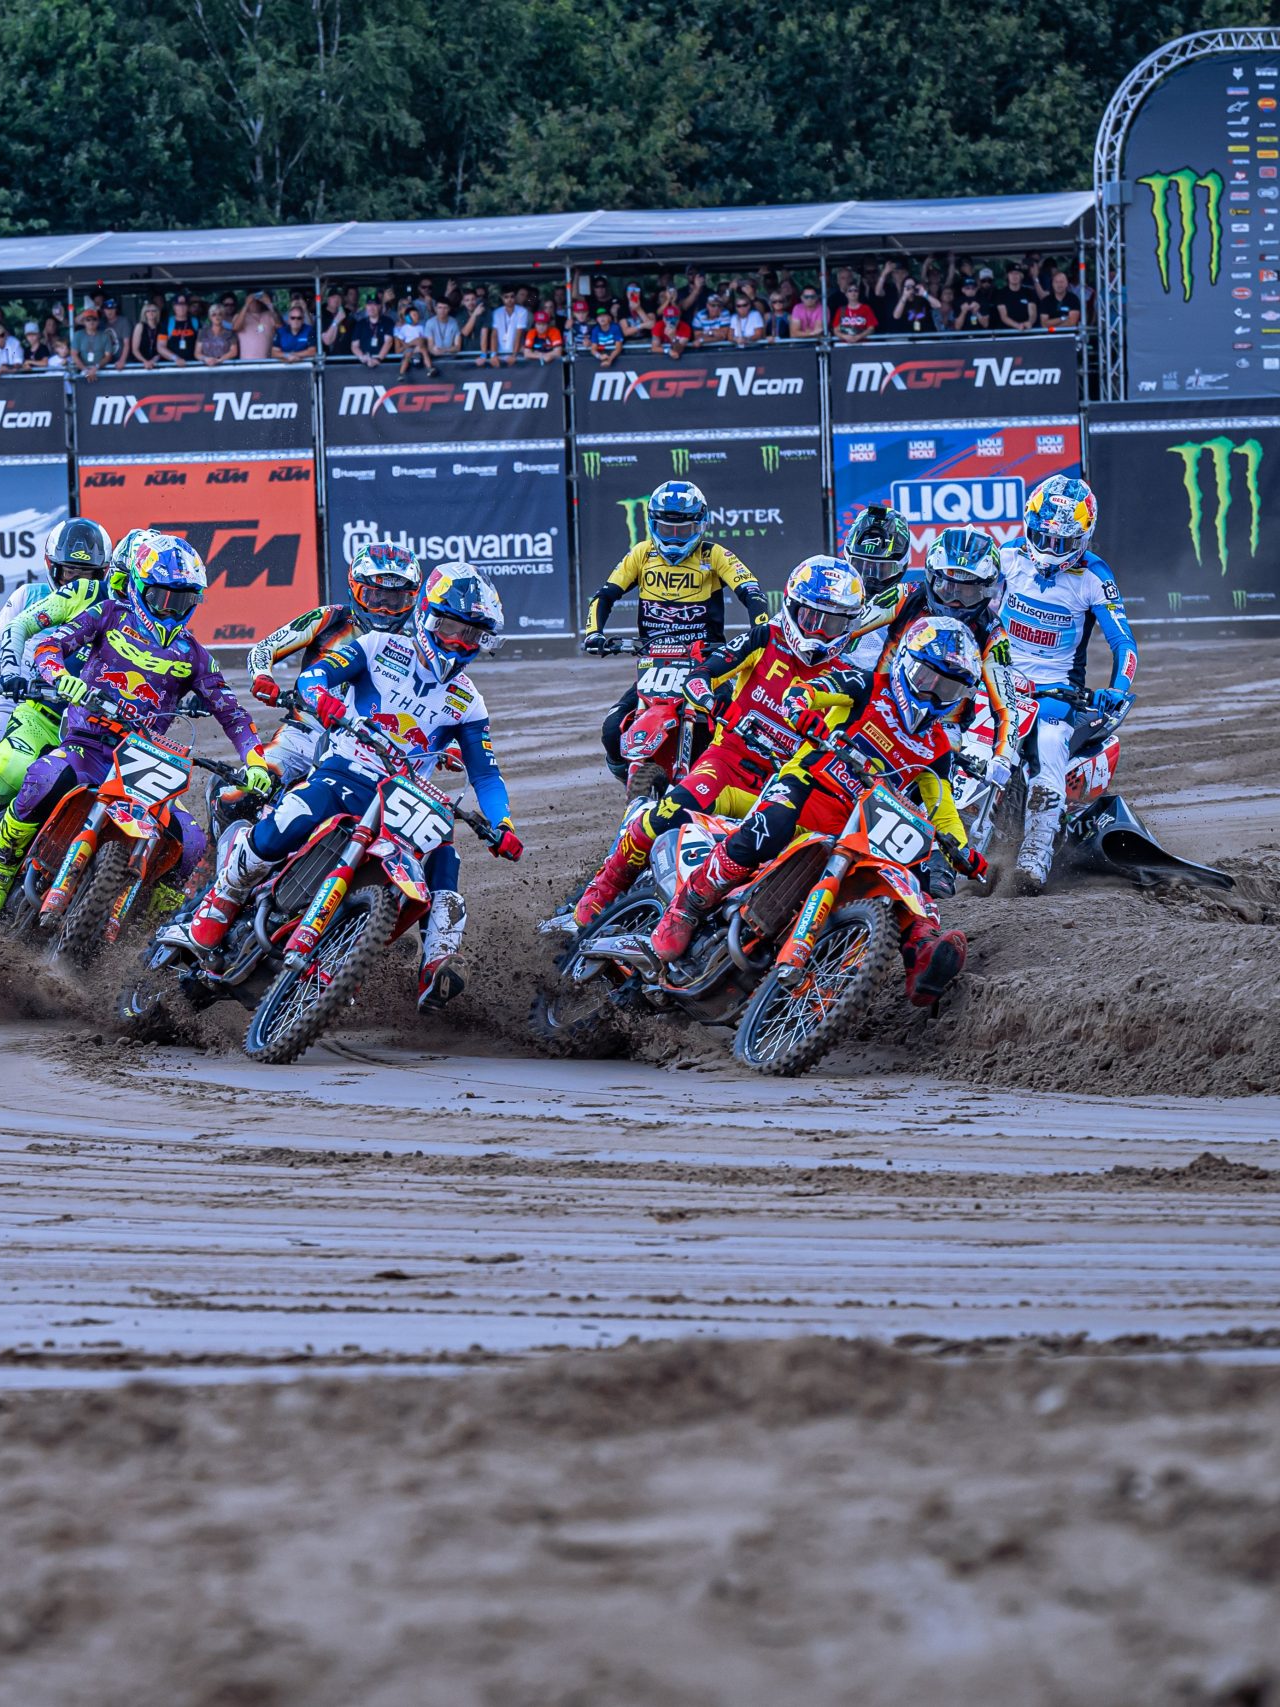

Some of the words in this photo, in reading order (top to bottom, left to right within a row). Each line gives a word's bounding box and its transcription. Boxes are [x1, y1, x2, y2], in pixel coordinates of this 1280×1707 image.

[849, 443, 875, 451] LIQUI
[908, 440, 935, 449] LIQUI
[977, 437, 1003, 447] LIQUI
[1036, 435, 1064, 445] LIQUI
[849, 451, 876, 461] MOLY
[908, 449, 936, 459] MOLY
[977, 446, 1004, 456] MOLY
[1036, 445, 1064, 454] MOLY
[84, 472, 125, 487] KTM
[144, 470, 187, 486] KTM
[206, 468, 249, 484] KTM
[268, 466, 310, 482] KTM
[898, 481, 1018, 522] LIQUI
[703, 528, 768, 538] NERGY
[1016, 599, 1072, 622] Husqvarna
[1009, 619, 1057, 647] nestaan
[385, 648, 410, 666] AIROH
[381, 671, 401, 683] DEKRA
[137, 740, 170, 762] MOTOREX
[118, 746, 188, 800] 72
[404, 781, 435, 806] MOTOREX
[884, 794, 915, 822] MOTOREX
[383, 786, 452, 854] 516
[867, 806, 925, 865] 19
[304, 889, 328, 923] MOTOREX
[795, 902, 817, 937] MOTOREX
